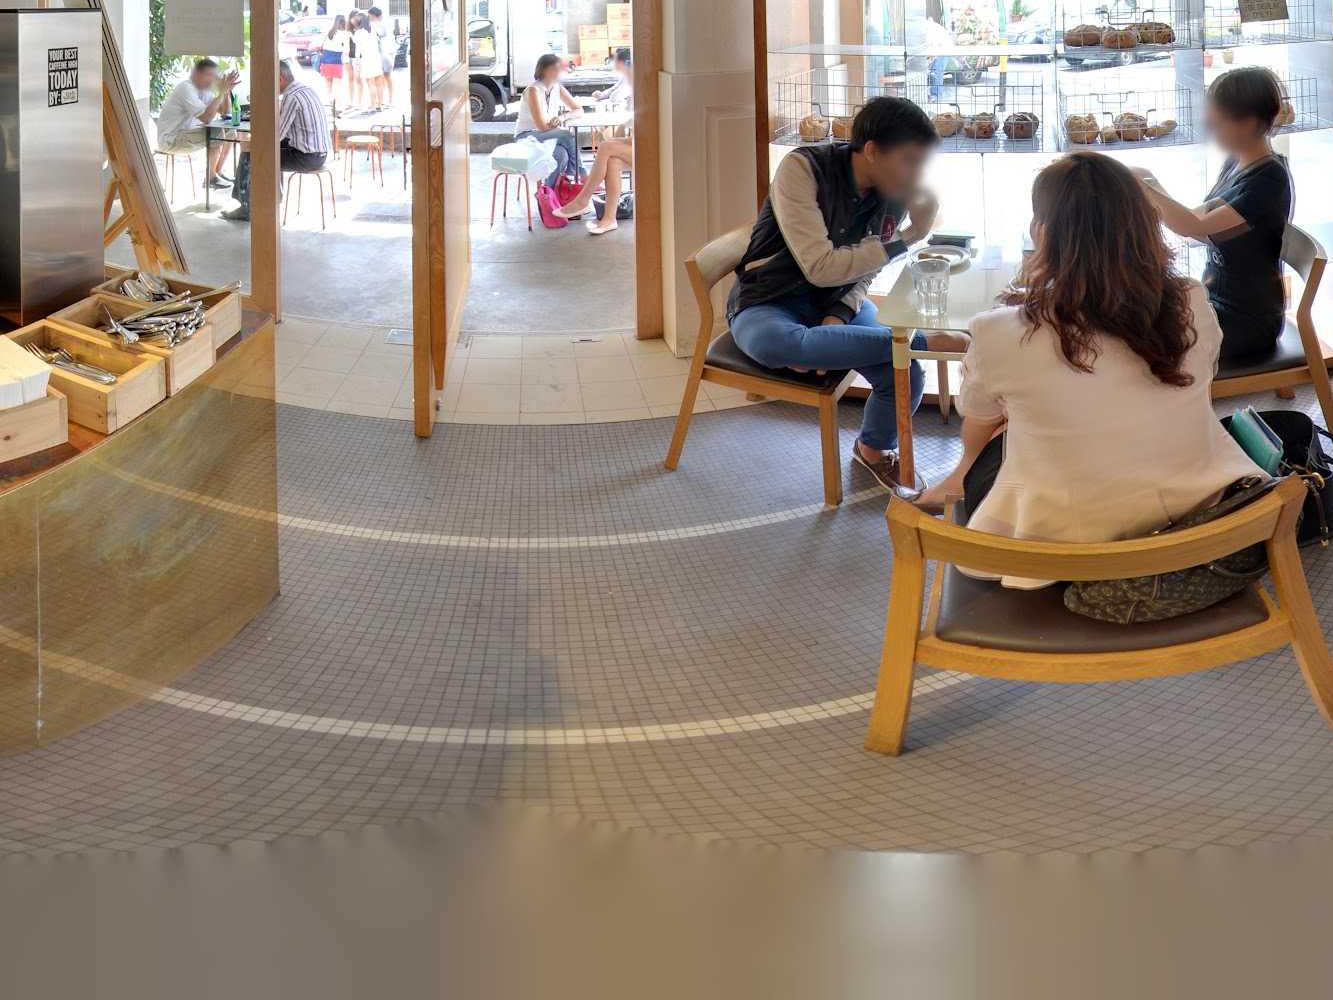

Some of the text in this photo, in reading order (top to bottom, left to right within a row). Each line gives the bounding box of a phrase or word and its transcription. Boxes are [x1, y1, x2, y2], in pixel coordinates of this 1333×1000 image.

[49, 49, 77, 61] YOUR BEST
[49, 61, 67, 70] CAFFEINE
[49, 70, 77, 90] TODAY
[49, 91, 60, 105] BY:
